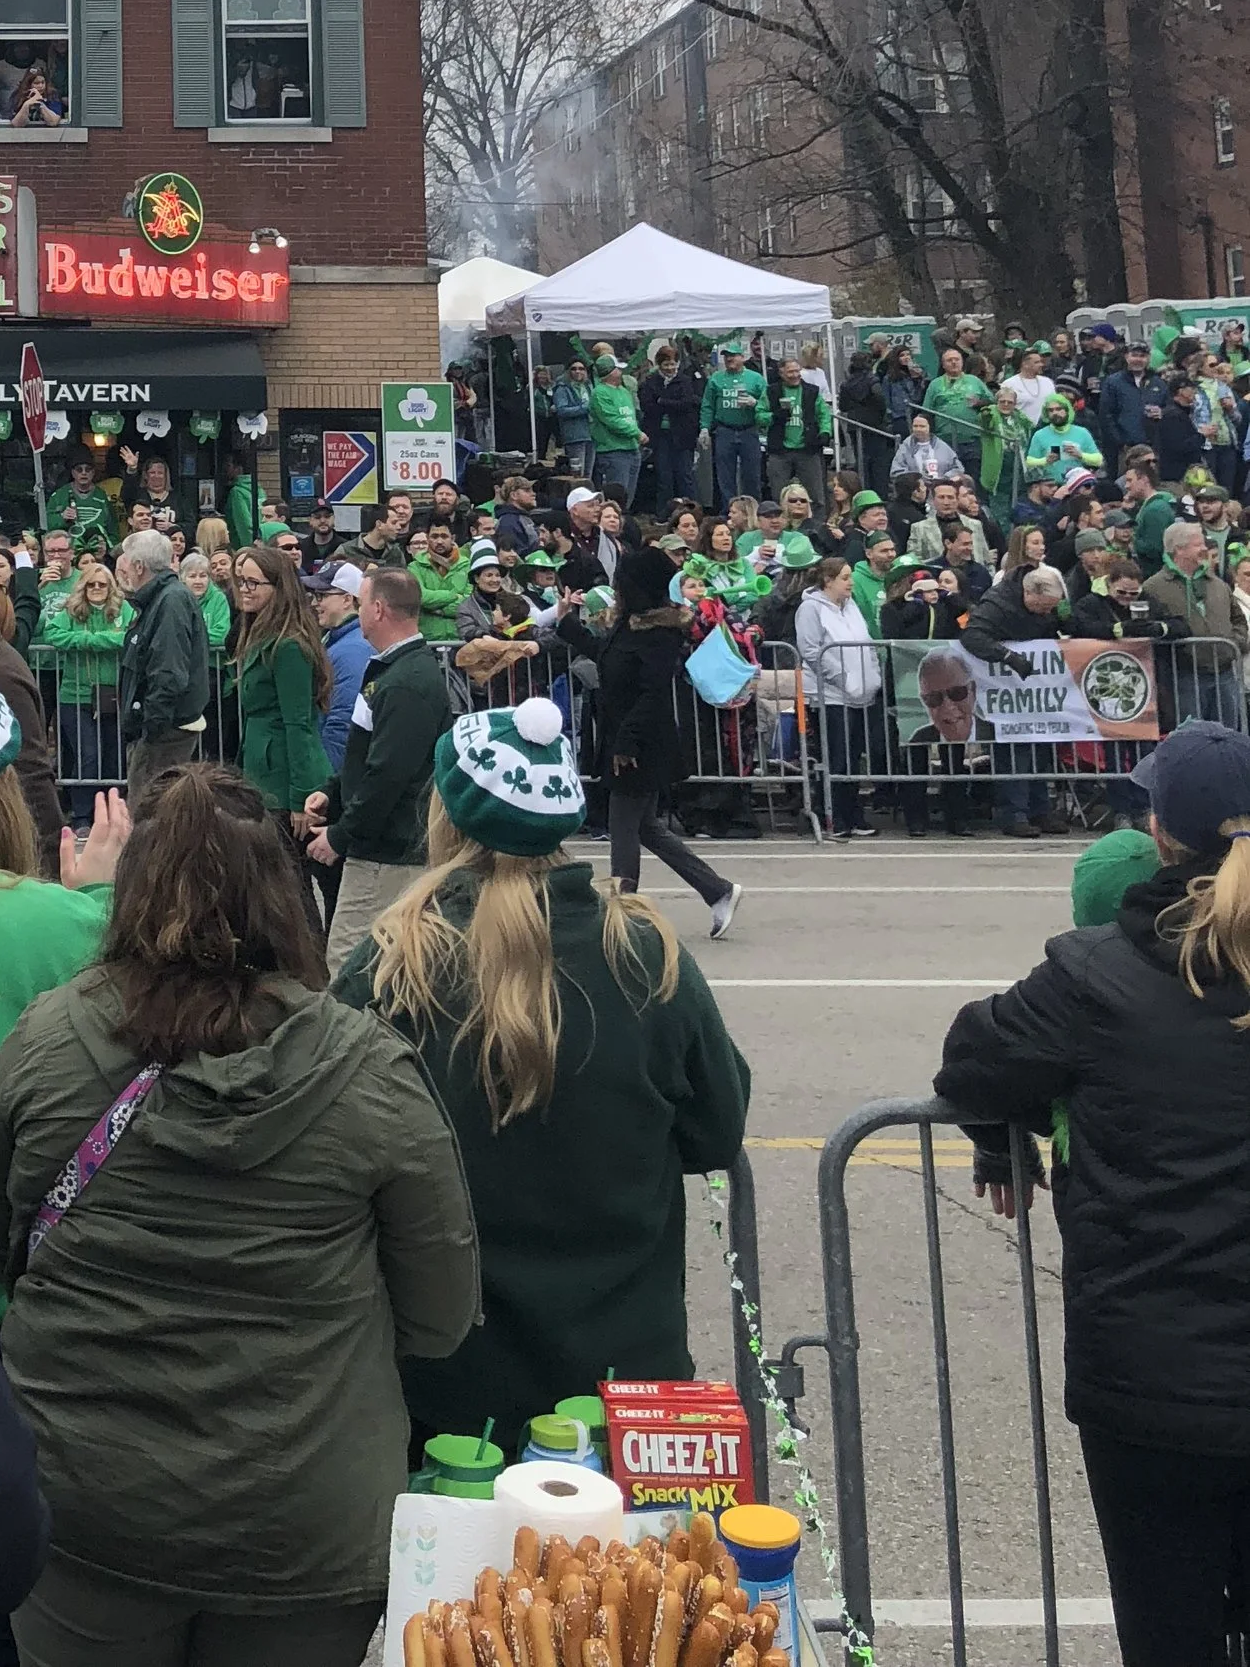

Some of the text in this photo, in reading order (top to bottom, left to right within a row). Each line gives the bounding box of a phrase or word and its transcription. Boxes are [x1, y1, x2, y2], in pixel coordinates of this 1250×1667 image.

[45, 242, 288, 303] Budweiser
[24, 376, 45, 419] STOP
[42, 379, 151, 403] TAVERN
[327, 443, 352, 451] WE PAY
[420, 450, 440, 458] Cans
[327, 460, 347, 468] WAGE
[392, 461, 442, 480] $8.00
[986, 687, 1068, 713] FAMILY
[632, 1482, 688, 1506] Snack
